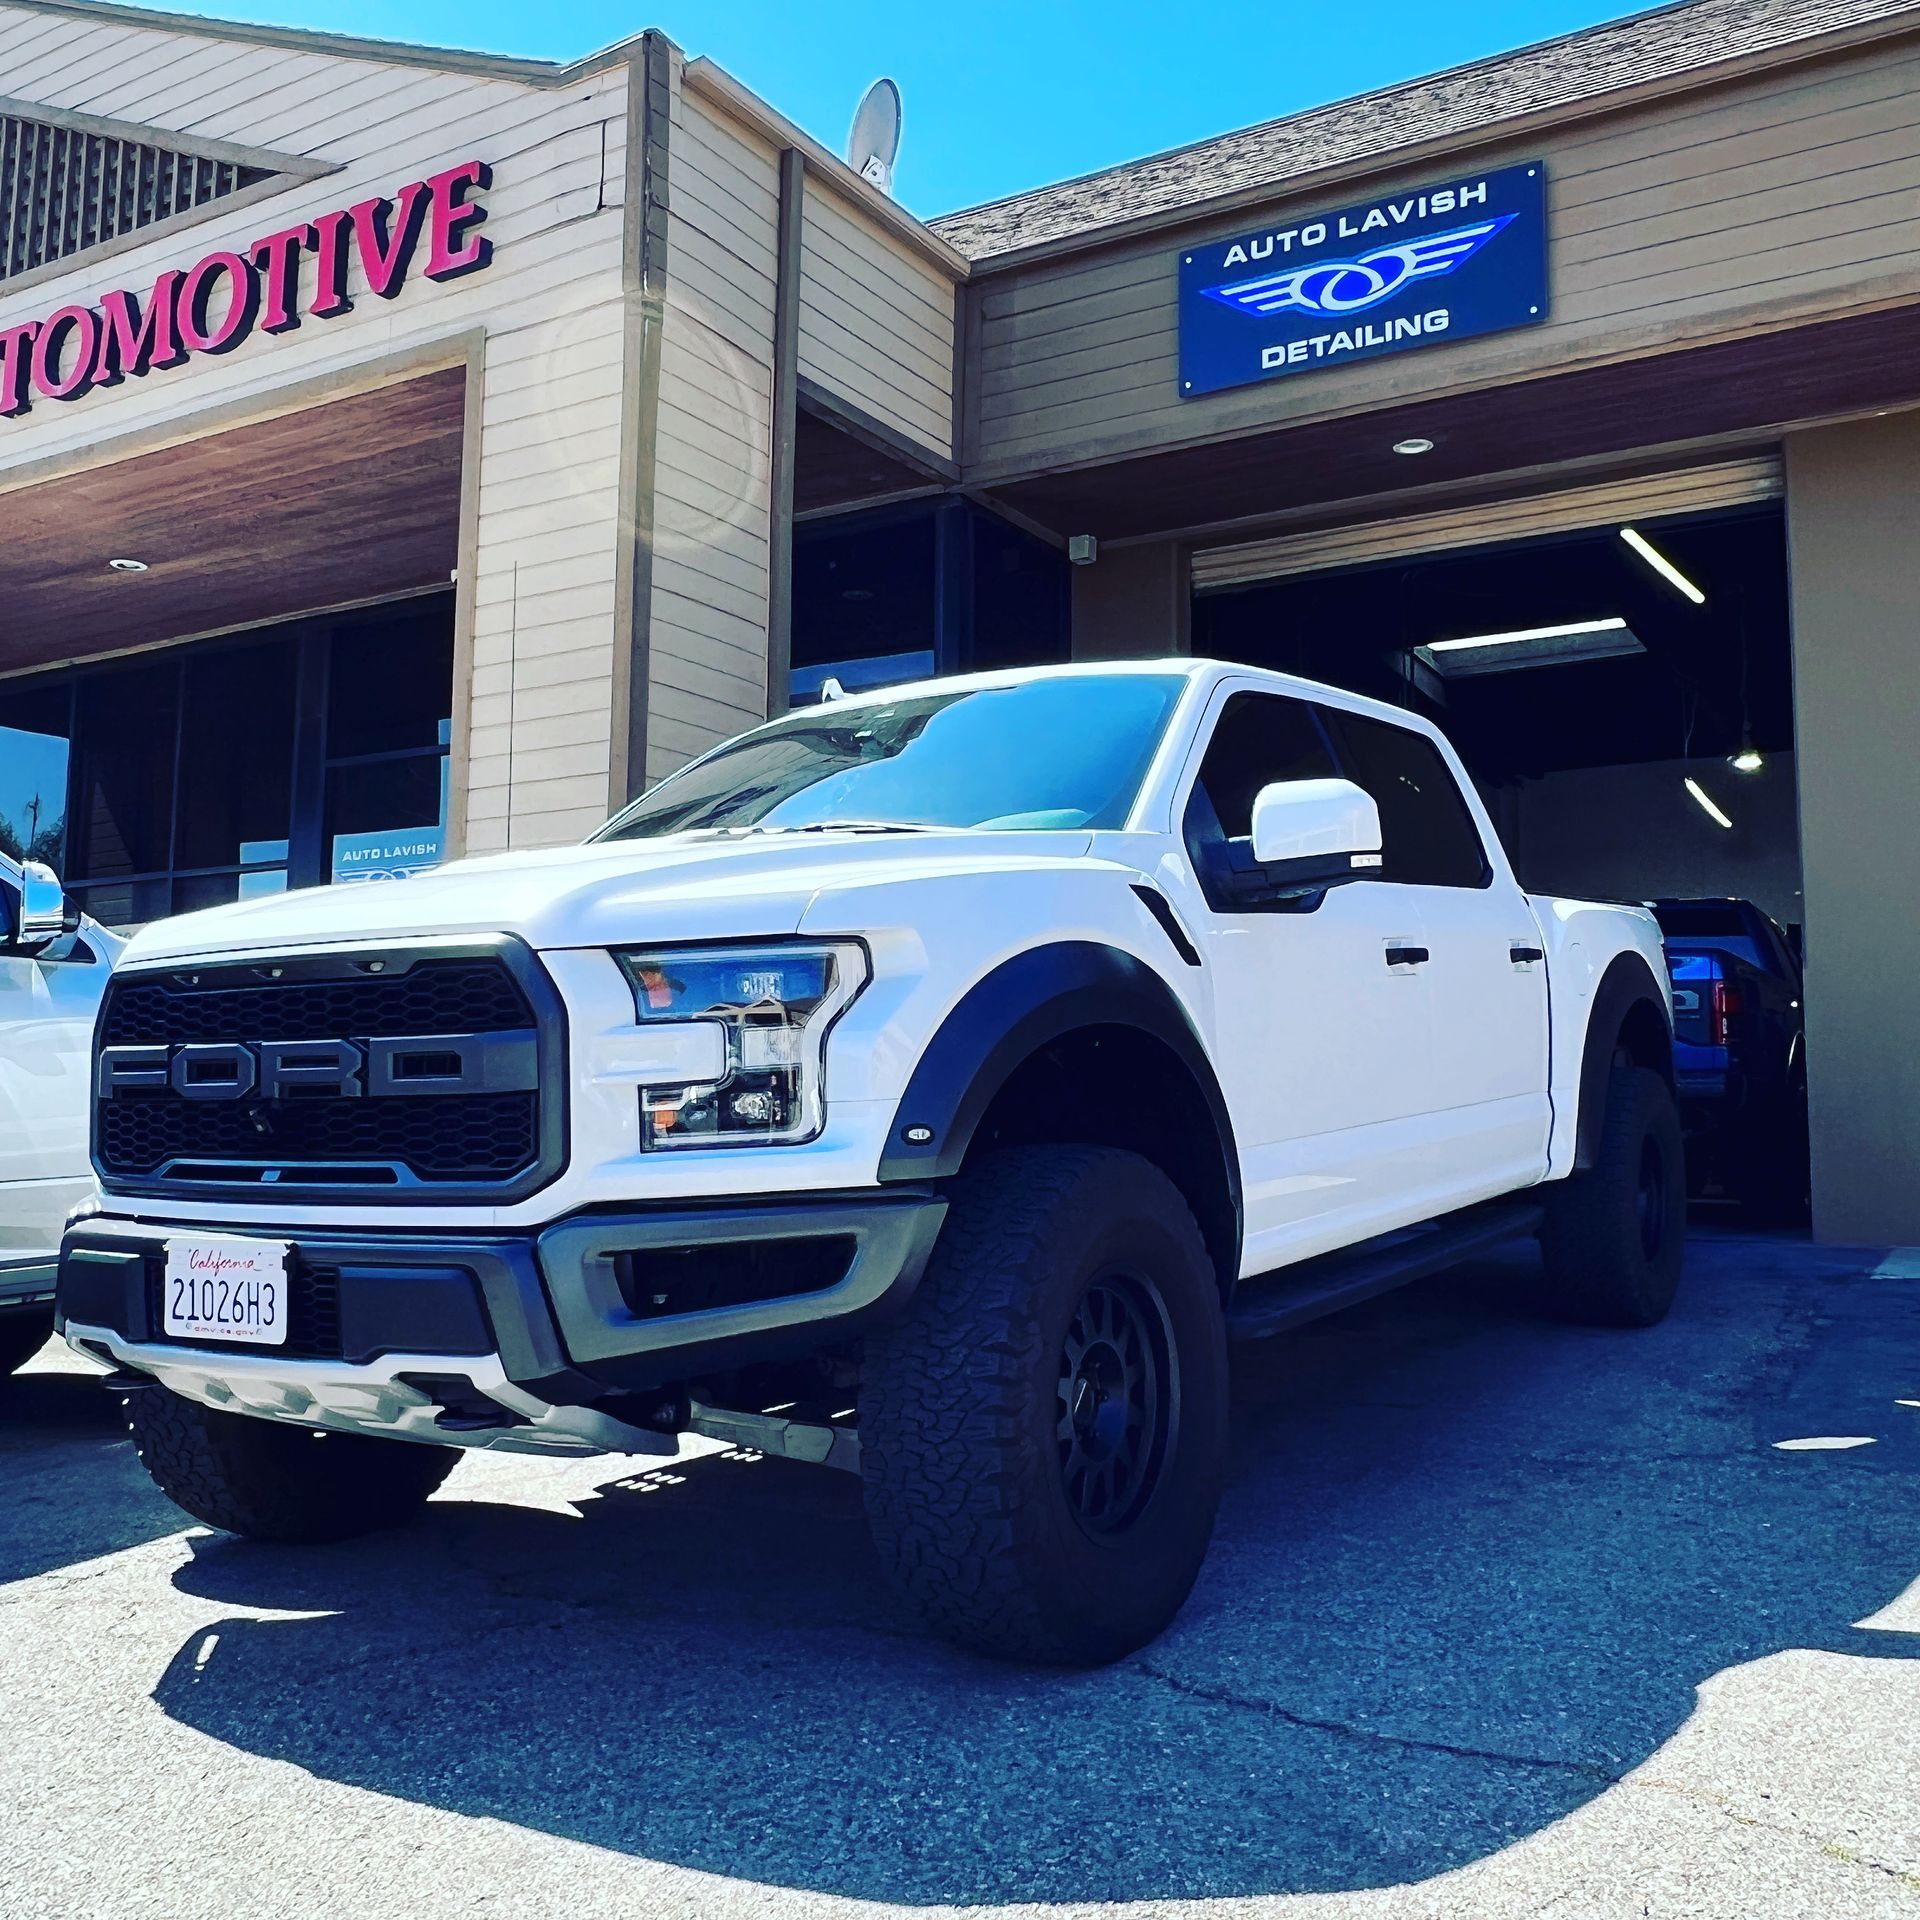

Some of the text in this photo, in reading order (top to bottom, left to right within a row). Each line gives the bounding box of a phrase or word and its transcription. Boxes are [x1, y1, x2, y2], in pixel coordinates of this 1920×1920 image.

[1222, 181, 1488, 268] AUTO LAVISH
[0, 161, 492, 417] TOMOTIVE
[1260, 308, 1450, 370] DETAILING
[342, 843, 437, 862] AUTO LAVISH
[99, 1033, 486, 1099] FORD
[189, 1249, 256, 1277] California
[172, 1277, 275, 1326] 21026H3
